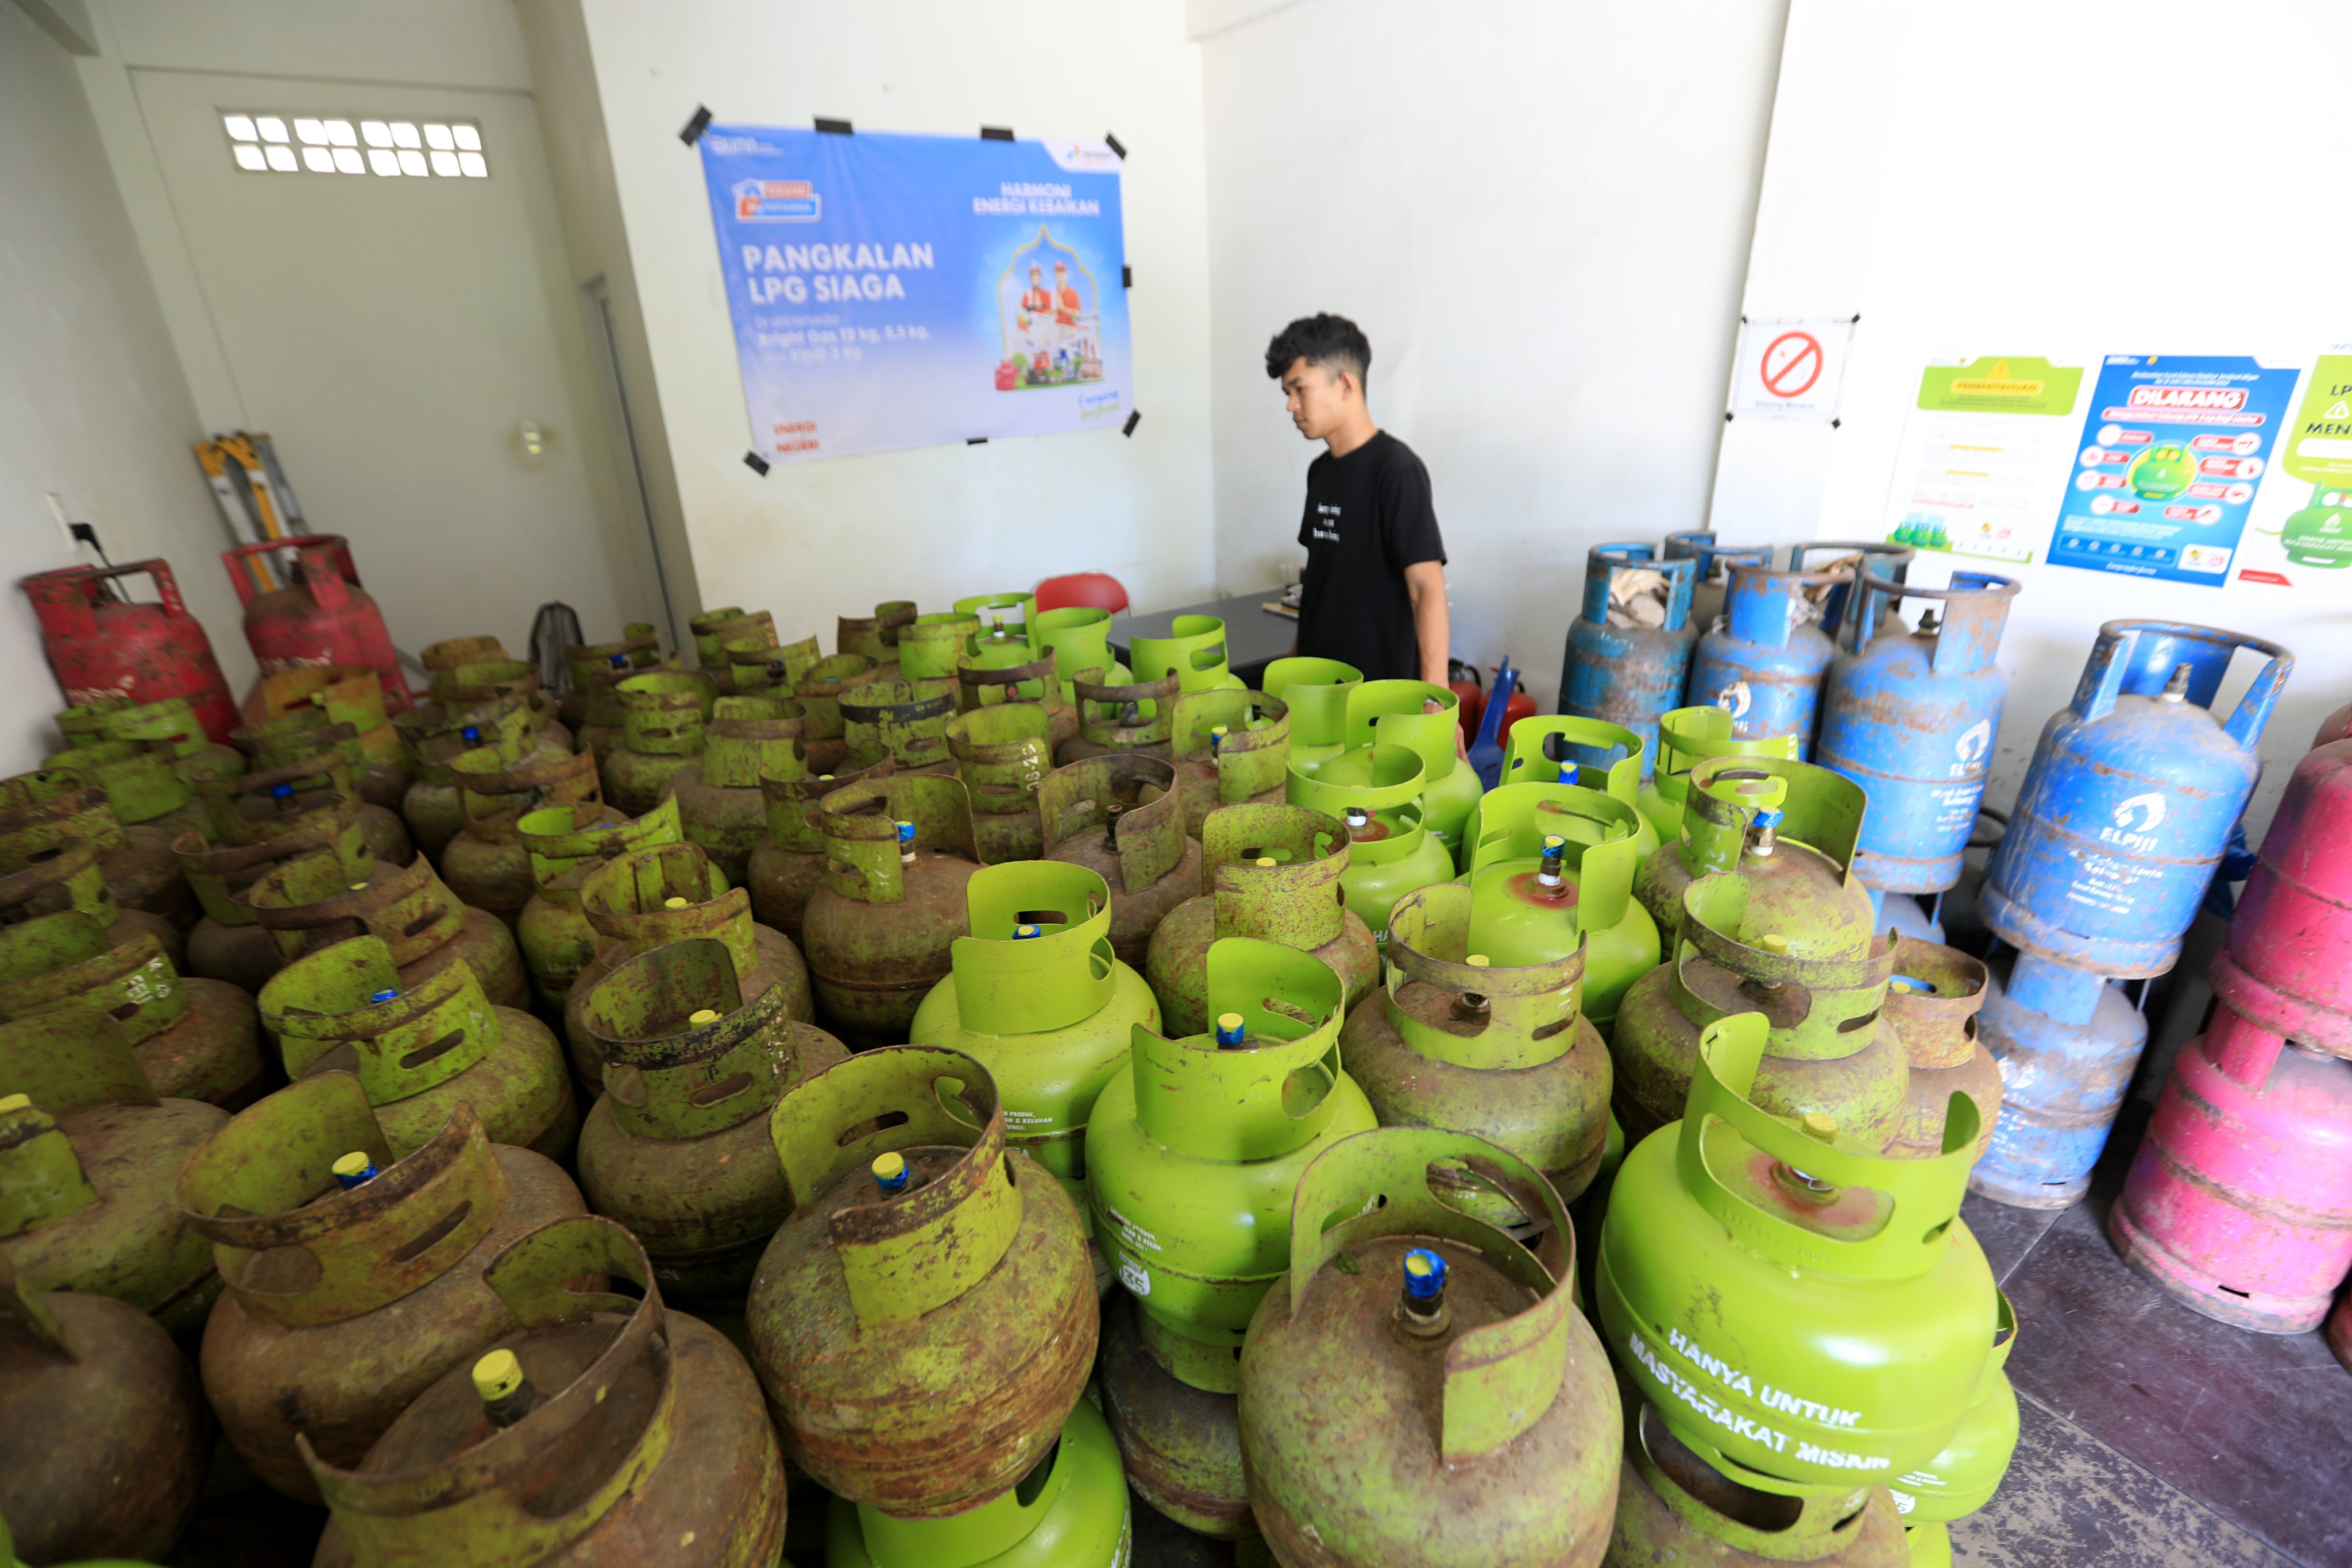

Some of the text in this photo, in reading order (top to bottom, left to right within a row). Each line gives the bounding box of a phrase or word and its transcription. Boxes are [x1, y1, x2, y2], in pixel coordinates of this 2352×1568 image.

[1001, 182, 1072, 198] HARMONI
[973, 198, 1100, 217] ENERGI KEBAIKAN
[742, 243, 934, 273] PANGKALAN
[748, 273, 905, 304] LPG SIAGA
[808, 329, 836, 343] Gas
[2134, 390, 2242, 409] DILARANG
[2099, 827, 2158, 853] ELPIJI
[1669, 1327, 1862, 1426] HANYA UNTUK
[1629, 1332, 1788, 1453] MASYARAKAT
